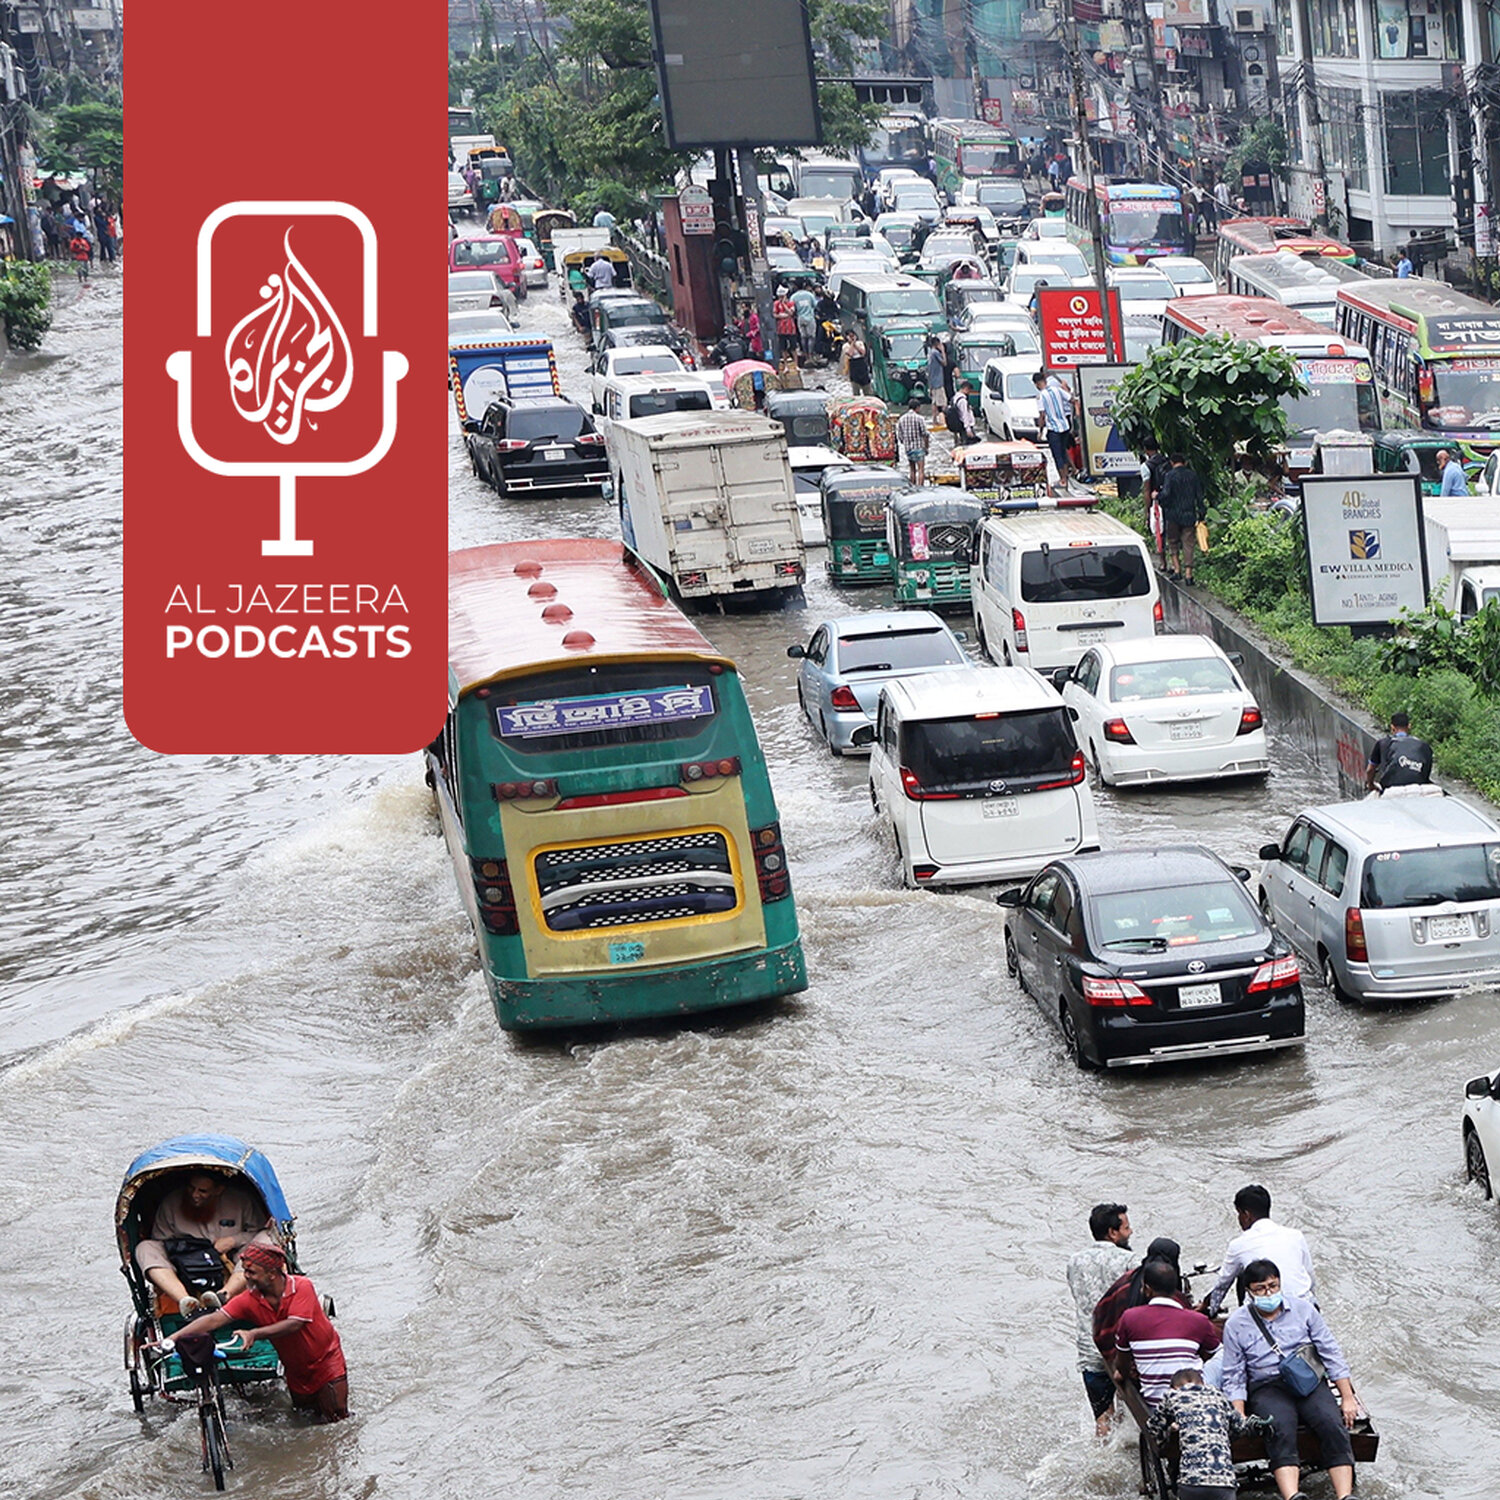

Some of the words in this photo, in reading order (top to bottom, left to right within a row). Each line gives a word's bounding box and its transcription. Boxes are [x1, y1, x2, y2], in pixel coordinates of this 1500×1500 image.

[1342, 508, 1382, 520] BRANCHES
[1320, 564, 1342, 574] EW
[1342, 563, 1373, 573] VILLA
[1374, 562, 1414, 572] MEDICA
